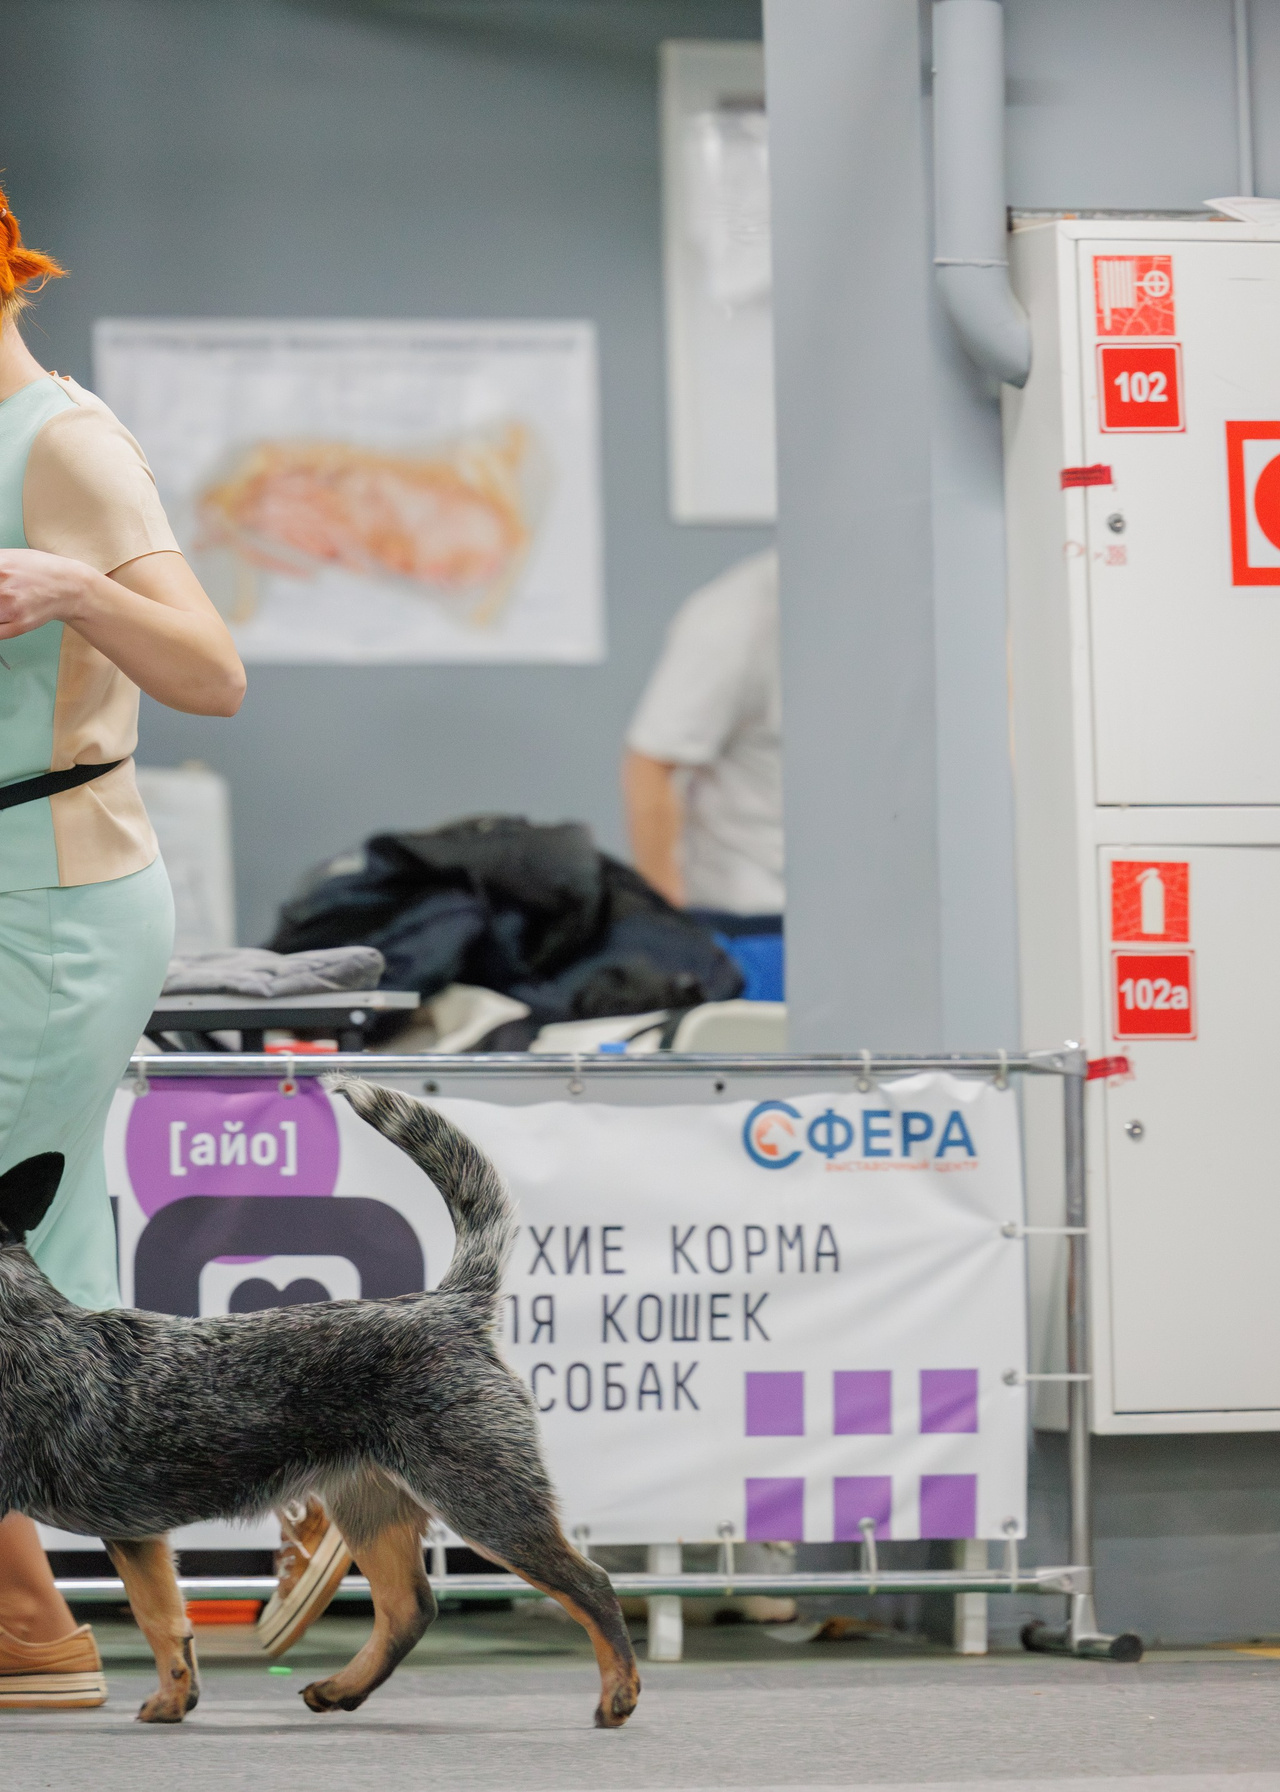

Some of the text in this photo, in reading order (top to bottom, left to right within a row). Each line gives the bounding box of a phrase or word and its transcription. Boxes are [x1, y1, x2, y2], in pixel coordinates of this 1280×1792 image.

[1114, 371, 1168, 403] 102
[742, 1100, 977, 1170] СФЕРА
[513, 1225, 839, 1275] ХИЕ КОРМА
[602, 1293, 770, 1344] КОШЕК
[531, 1362, 700, 1412] СОБАК
